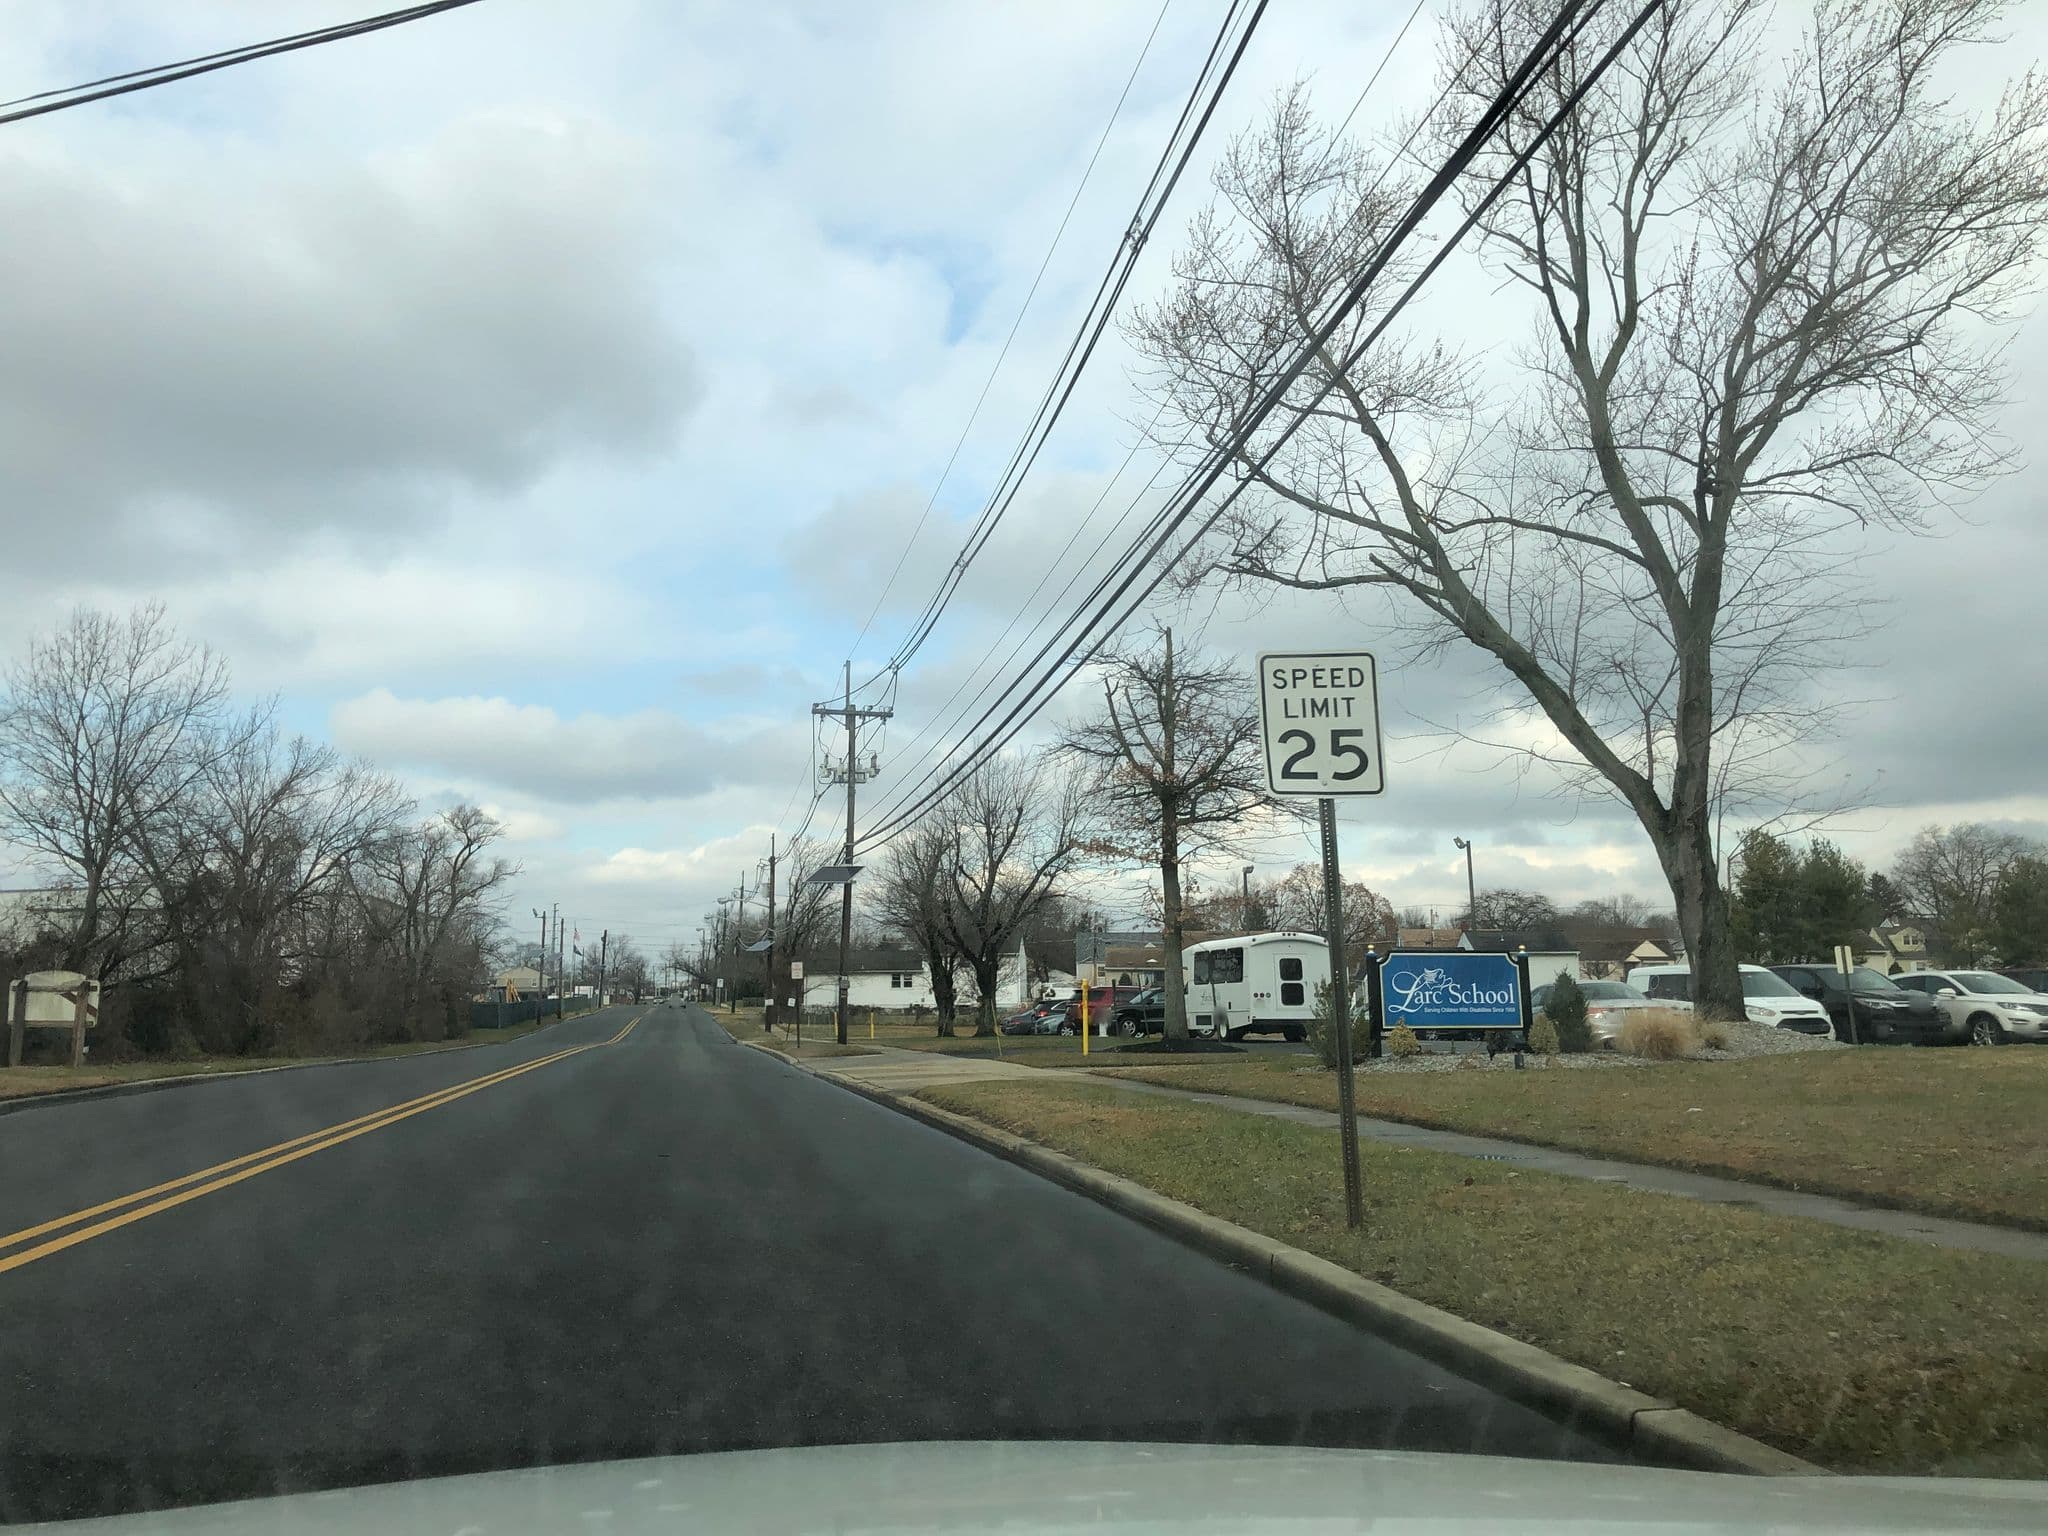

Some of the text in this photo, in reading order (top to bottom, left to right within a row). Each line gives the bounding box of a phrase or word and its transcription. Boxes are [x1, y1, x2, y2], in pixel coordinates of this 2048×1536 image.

[1272, 667, 1365, 690] SPEED
[1283, 697, 1356, 719] LIMIT
[1277, 728, 1369, 781] 25
[1388, 971, 1515, 1012] Larc School
